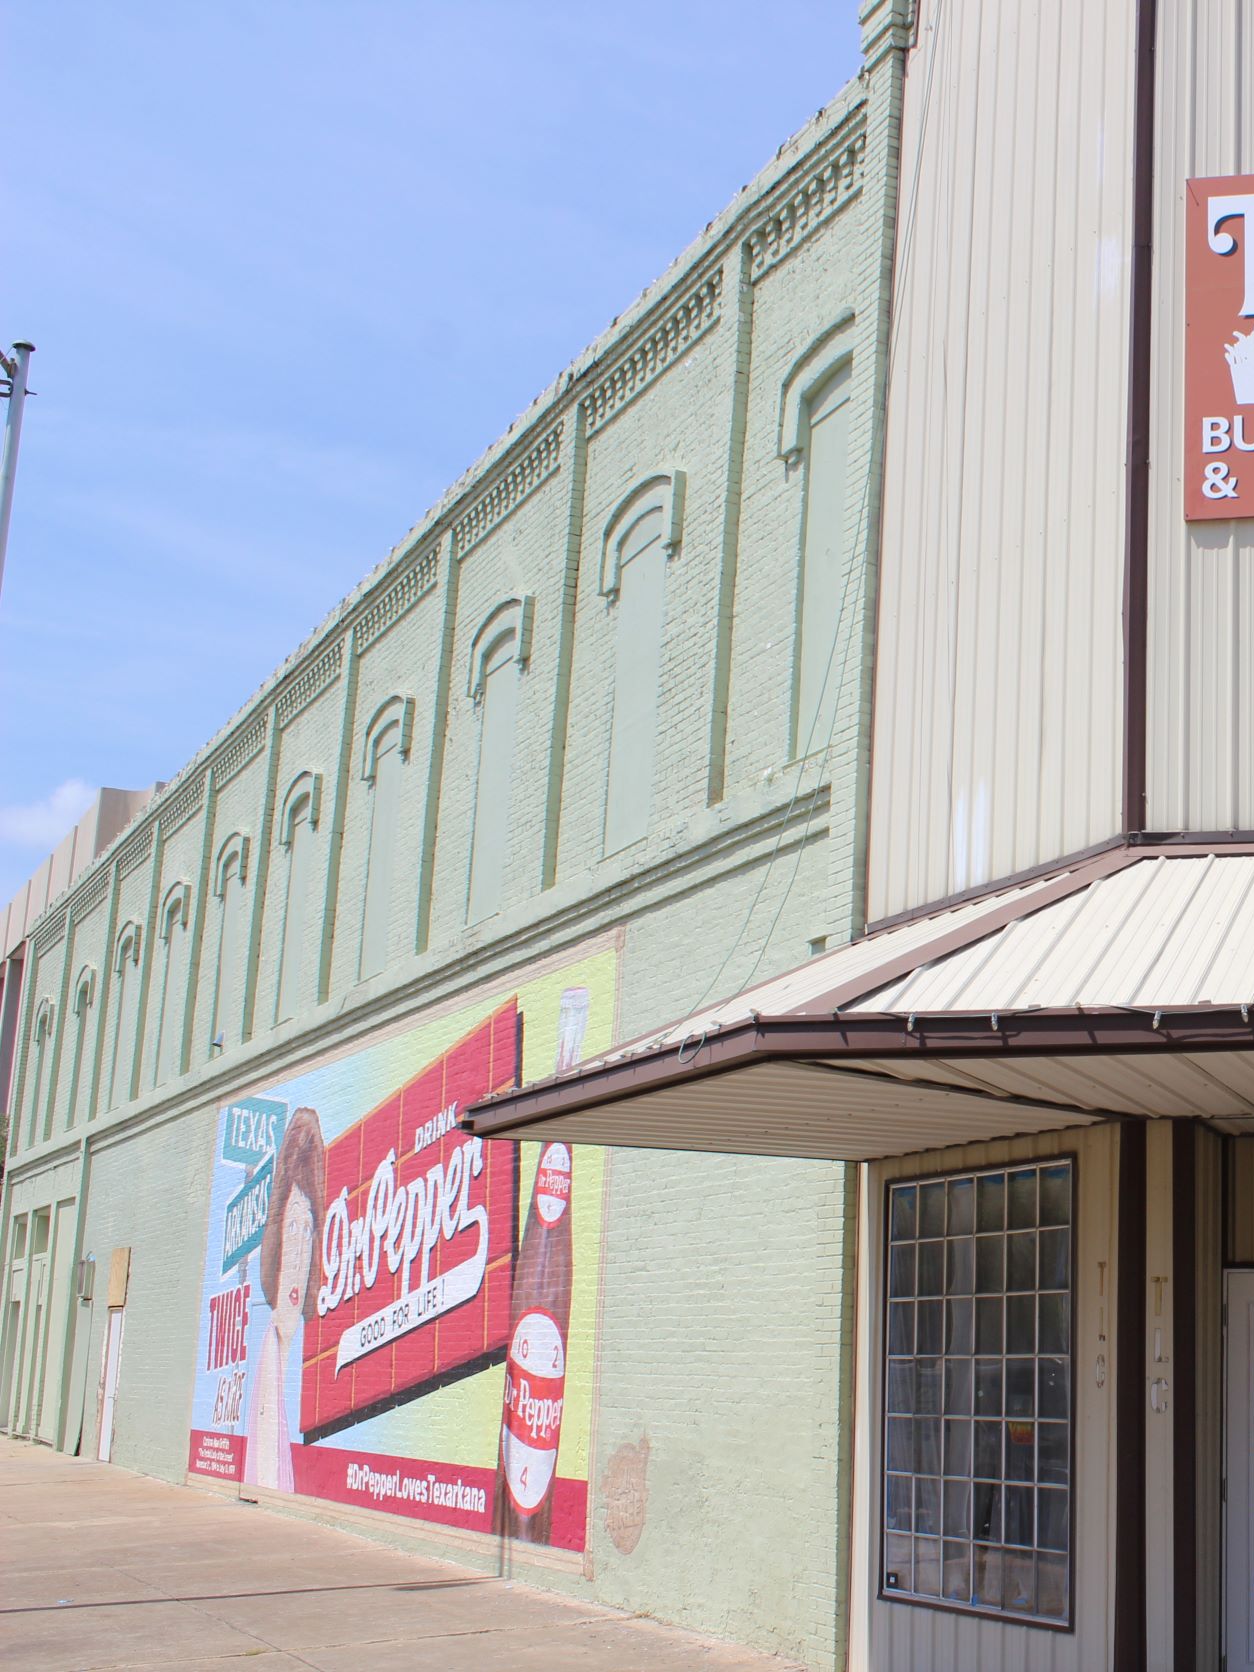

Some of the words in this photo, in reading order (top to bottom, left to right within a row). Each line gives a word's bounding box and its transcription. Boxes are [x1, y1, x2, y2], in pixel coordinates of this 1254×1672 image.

[1201, 461, 1239, 500] &
[230, 1106, 278, 1154] TEXAS
[414, 1100, 458, 1155] DRINK
[545, 1169, 572, 1195] Pepper
[224, 1172, 272, 1262] ARKANSAS
[206, 1283, 252, 1372] TWICE
[360, 1317, 387, 1348] GOOD
[391, 1302, 411, 1328] FOR
[516, 1335, 530, 1359] 10
[551, 1344, 560, 1370] 2
[212, 1377, 227, 1426] AS
[505, 1372, 518, 1412] Dr
[517, 1377, 564, 1440] Pepper
[518, 1465, 530, 1493] 4
